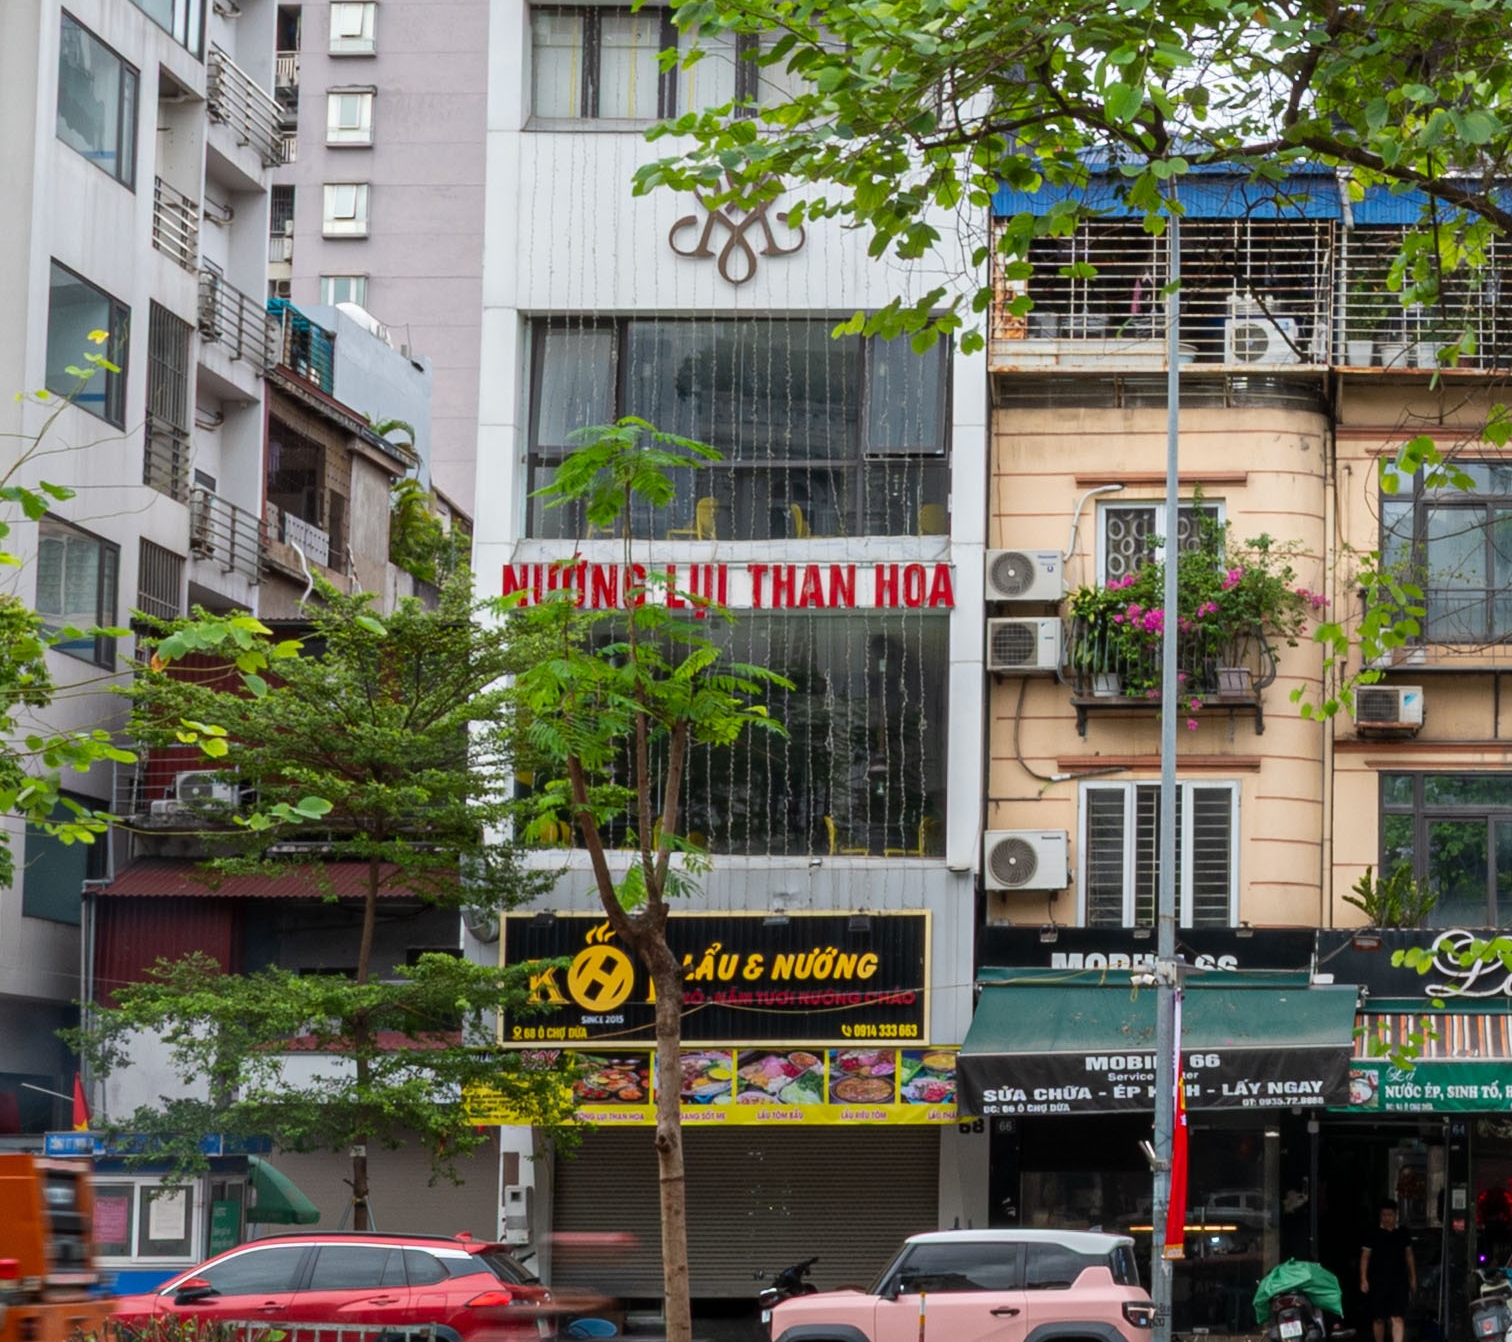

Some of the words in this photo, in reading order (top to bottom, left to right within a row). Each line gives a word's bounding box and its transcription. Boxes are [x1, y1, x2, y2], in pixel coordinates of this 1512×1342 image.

[502, 553, 646, 609] NƯỚNG
[747, 563, 856, 608] THAN
[875, 563, 955, 608] HOA
[682, 942, 740, 980] LẨU
[743, 954, 764, 980] &
[771, 945, 879, 980] NƯỚNG
[581, 1015, 604, 1025] SINCE
[605, 1015, 624, 1025] 2015
[523, 1026, 536, 1039] 68
[538, 1024, 545, 1039] Ô
[546, 1026, 566, 1041] CHỢ
[568, 1025, 588, 1039] DỪA
[854, 1024, 877, 1038] 0914
[879, 1024, 897, 1037] 333
[898, 1024, 918, 1037] 663
[1190, 1054, 1221, 1069] 66
[1108, 1072, 1154, 1082] Service
[983, 1086, 1026, 1103] SỬA
[1033, 1085, 1092, 1102] CHỮA
[1113, 1081, 1141, 1100] ÉP
[1222, 1078, 1261, 1097] LẤY
[1267, 1079, 1324, 1095] NGAY
[1385, 1081, 1423, 1099] NƯỚC
[1425, 1082, 1445, 1101] ÉP,
[1447, 1085, 1478, 1099] SINH
[1480, 1080, 1503, 1101] TỐ,
[997, 1119, 1013, 1132] 66
